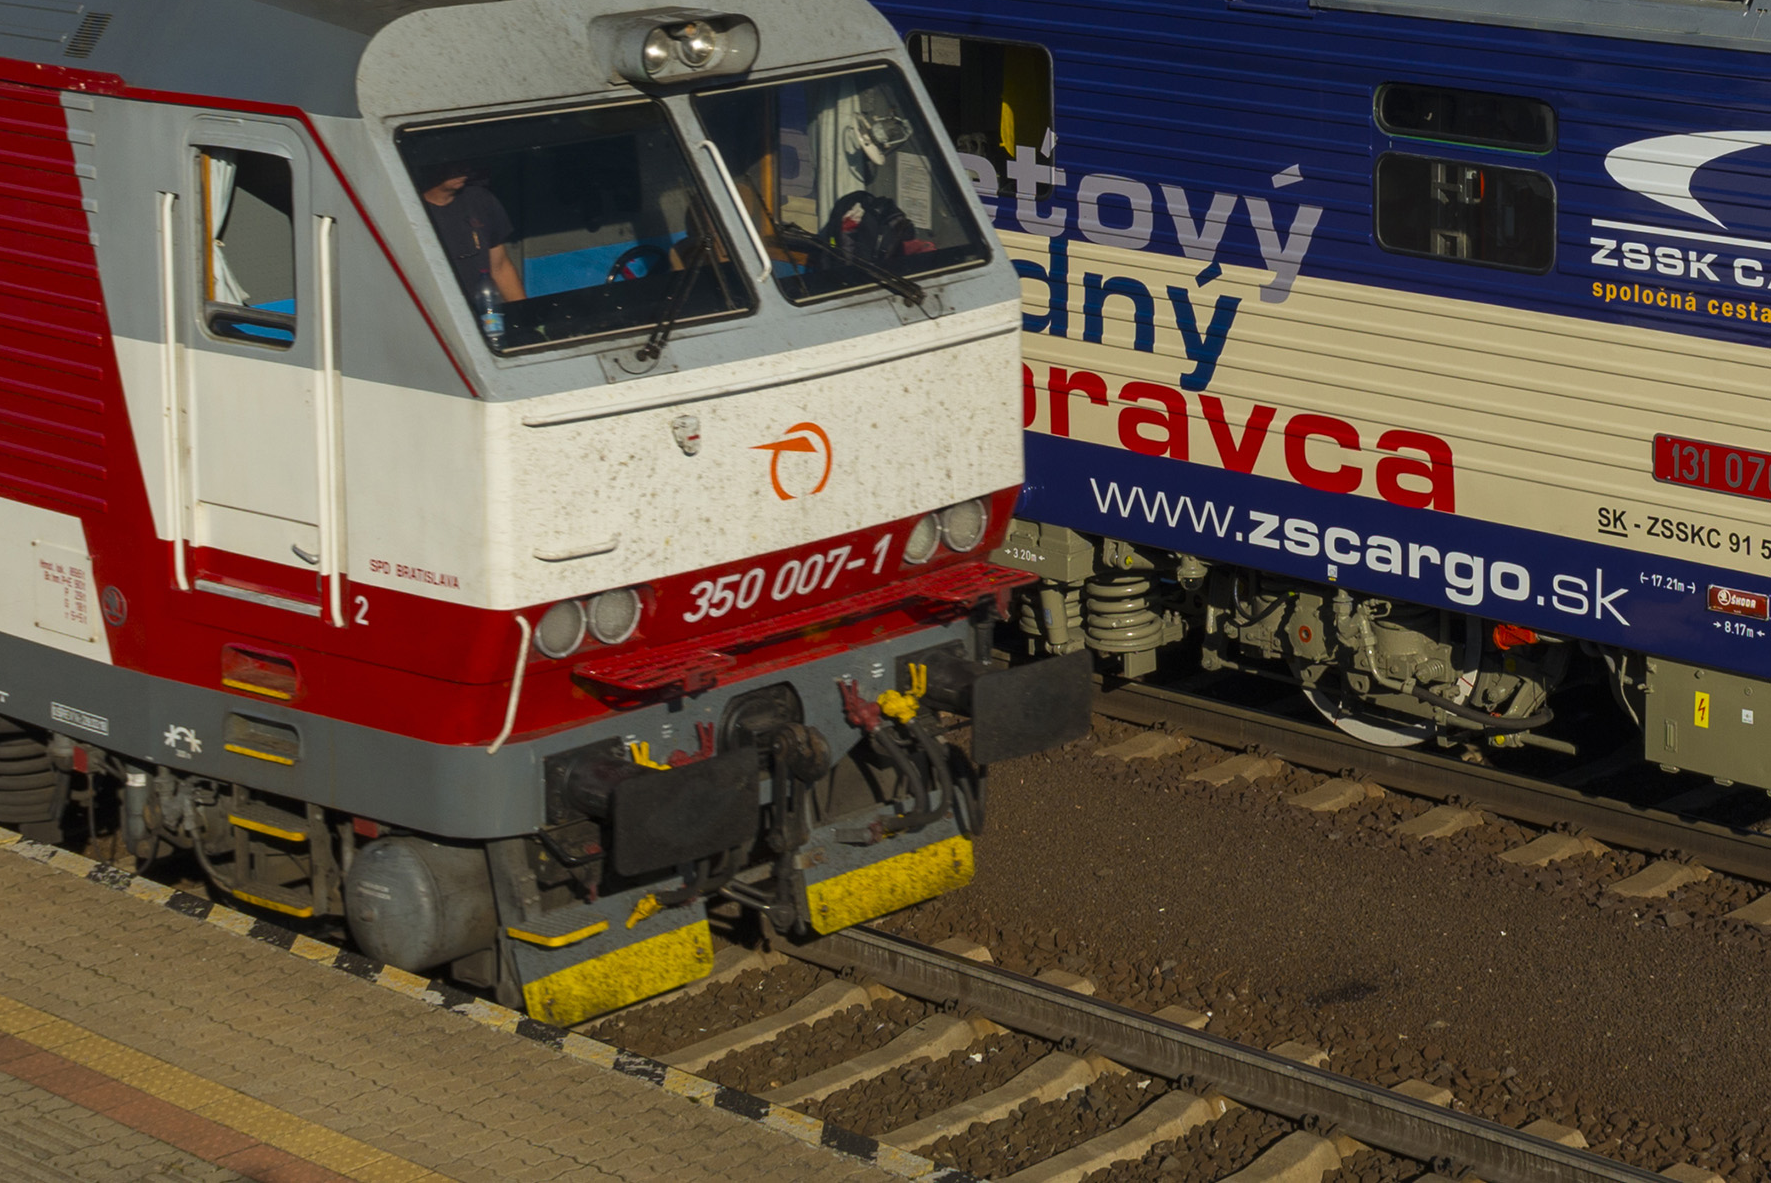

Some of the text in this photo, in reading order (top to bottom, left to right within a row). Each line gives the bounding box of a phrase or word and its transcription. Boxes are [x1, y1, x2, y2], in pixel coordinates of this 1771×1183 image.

[1590, 236, 1771, 290] ZSSK C
[1592, 281, 1771, 324] spoločná cesta
[1023, 362, 1455, 514] ravca
[1672, 443, 1771, 494] 131 07
[1090, 478, 1630, 626] www.zscargo.sk
[1598, 507, 1627, 531] SK
[1646, 516, 1721, 549] ZSSKC
[1729, 532, 1750, 556] 91
[369, 558, 460, 589] SPD BRATISLAVA
[1013, 547, 1037, 562] 3.20m
[683, 533, 893, 623] 350 007-1
[1651, 574, 1684, 592] 17.21m
[354, 595, 370, 626] 2
[1731, 594, 1756, 609] ŠKODA
[1724, 621, 1754, 638] 8.17m
